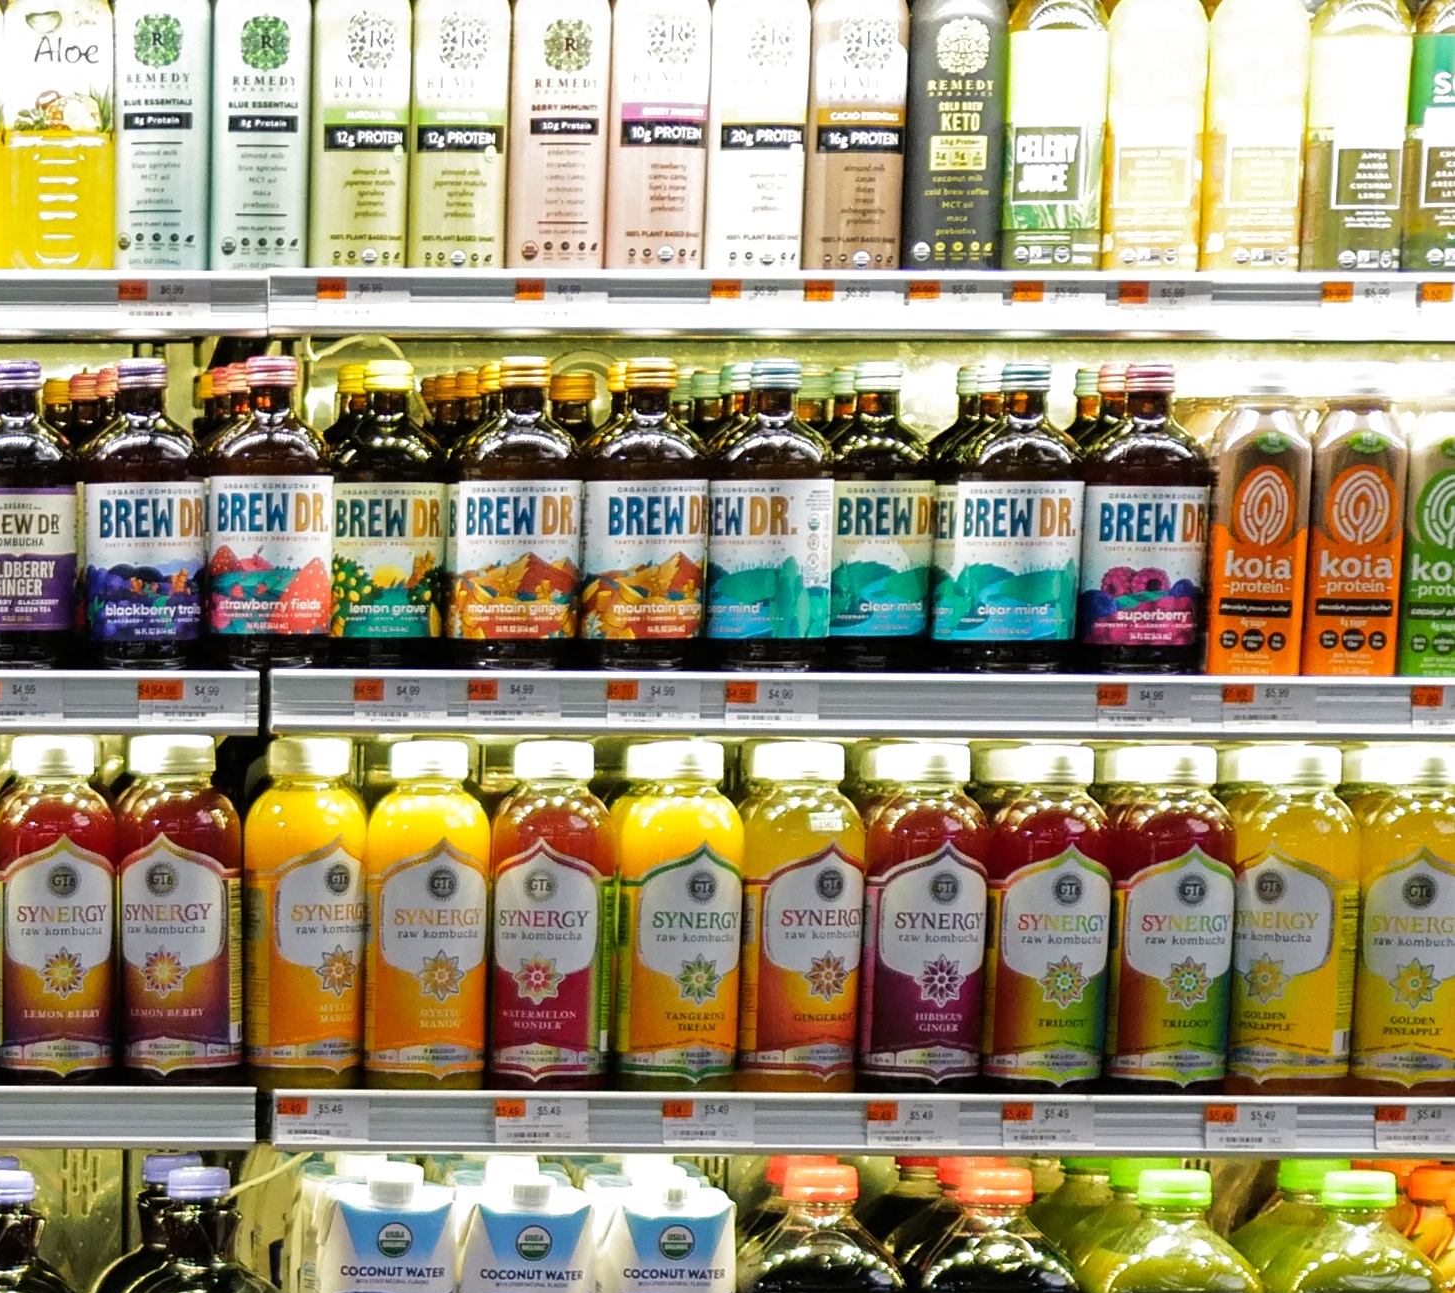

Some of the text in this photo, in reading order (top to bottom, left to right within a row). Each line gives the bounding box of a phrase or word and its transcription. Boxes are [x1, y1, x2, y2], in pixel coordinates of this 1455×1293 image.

[33, 36, 100, 64] Aloe
[928, 80, 994, 92] REMEDY
[941, 114, 980, 131] KETO
[359, 130, 403, 144] PROTEIN
[851, 131, 899, 146] PROTEIN
[217, 493, 288, 532] BREW
[964, 496, 1032, 538] BREW
[1223, 553, 1288, 583] koia
[1230, 579, 1284, 597] protein
[219, 598, 322, 613] strawberry fields
[349, 602, 427, 619] lemon grove
[1117, 609, 1191, 627] superberry
[16, 904, 107, 924] SYNERGY
[499, 909, 589, 929] SYNERGY
[896, 912, 983, 931] SYNERGY
[24, 1008, 101, 1019] LEMON BERRY
[914, 1012, 963, 1022] HIBISCUS
[918, 1023, 958, 1033] GINGER
[1038, 1019, 1086, 1029] TRILOGY
[340, 1266, 445, 1278] COCONUT WATER
